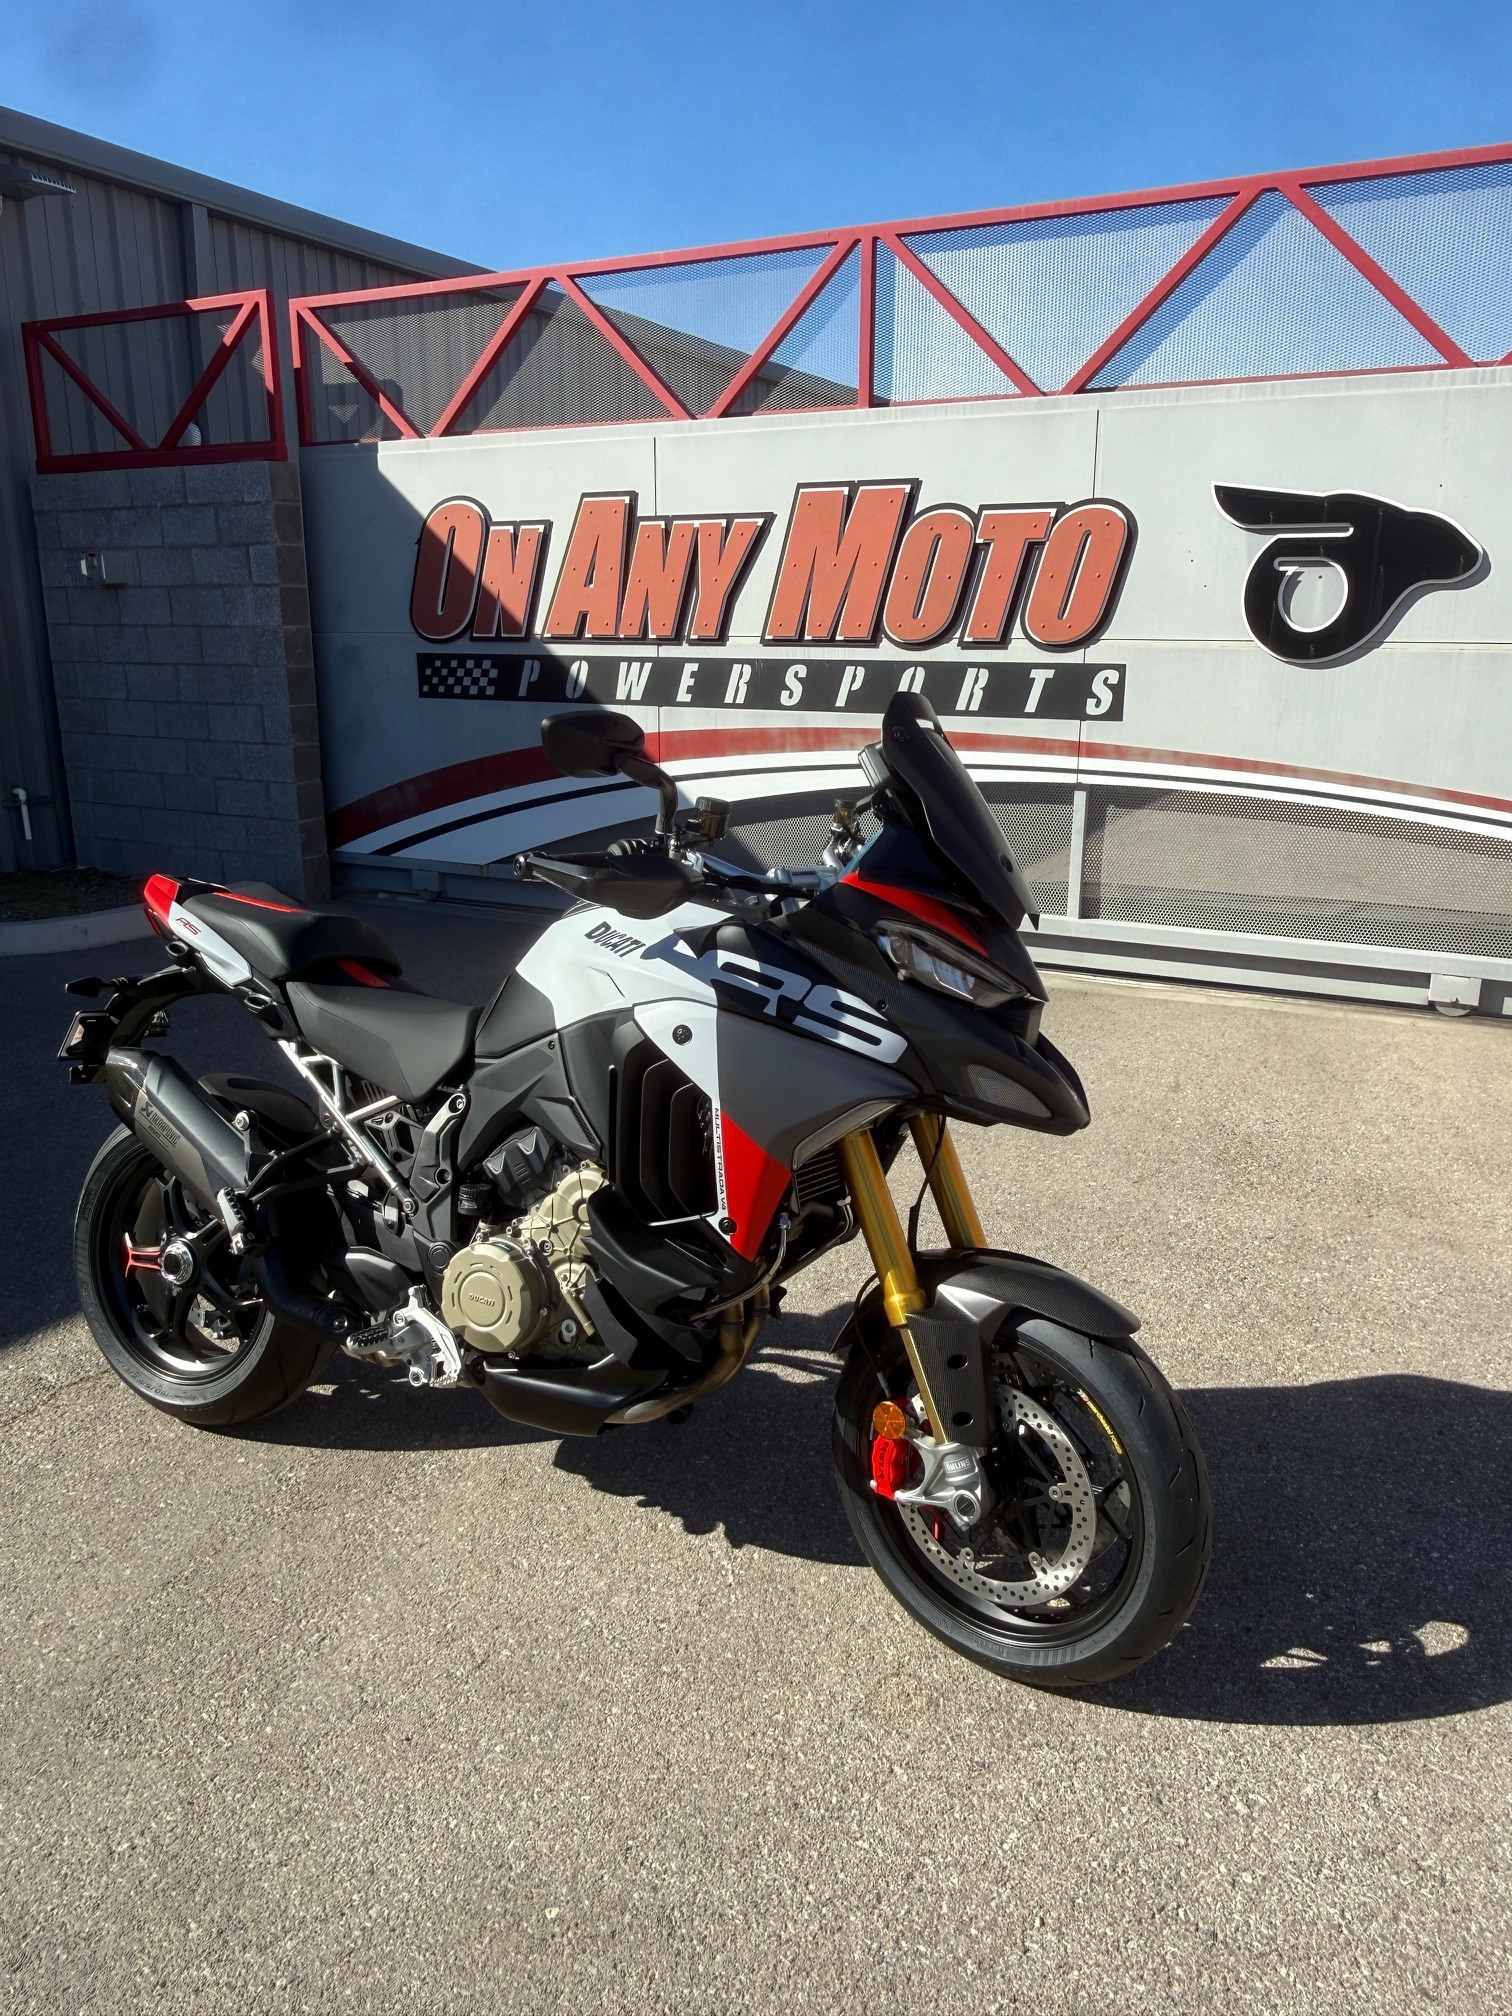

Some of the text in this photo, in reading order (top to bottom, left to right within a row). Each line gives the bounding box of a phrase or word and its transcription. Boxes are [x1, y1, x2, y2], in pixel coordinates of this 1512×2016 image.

[410, 478, 1140, 651] ON ANY MOTO
[517, 658, 1123, 715] POWERSPORTS
[584, 920, 647, 958] DUCATI
[714, 1107, 725, 1195] MULTISTRADA
[469, 1293, 496, 1307] DUCATI
